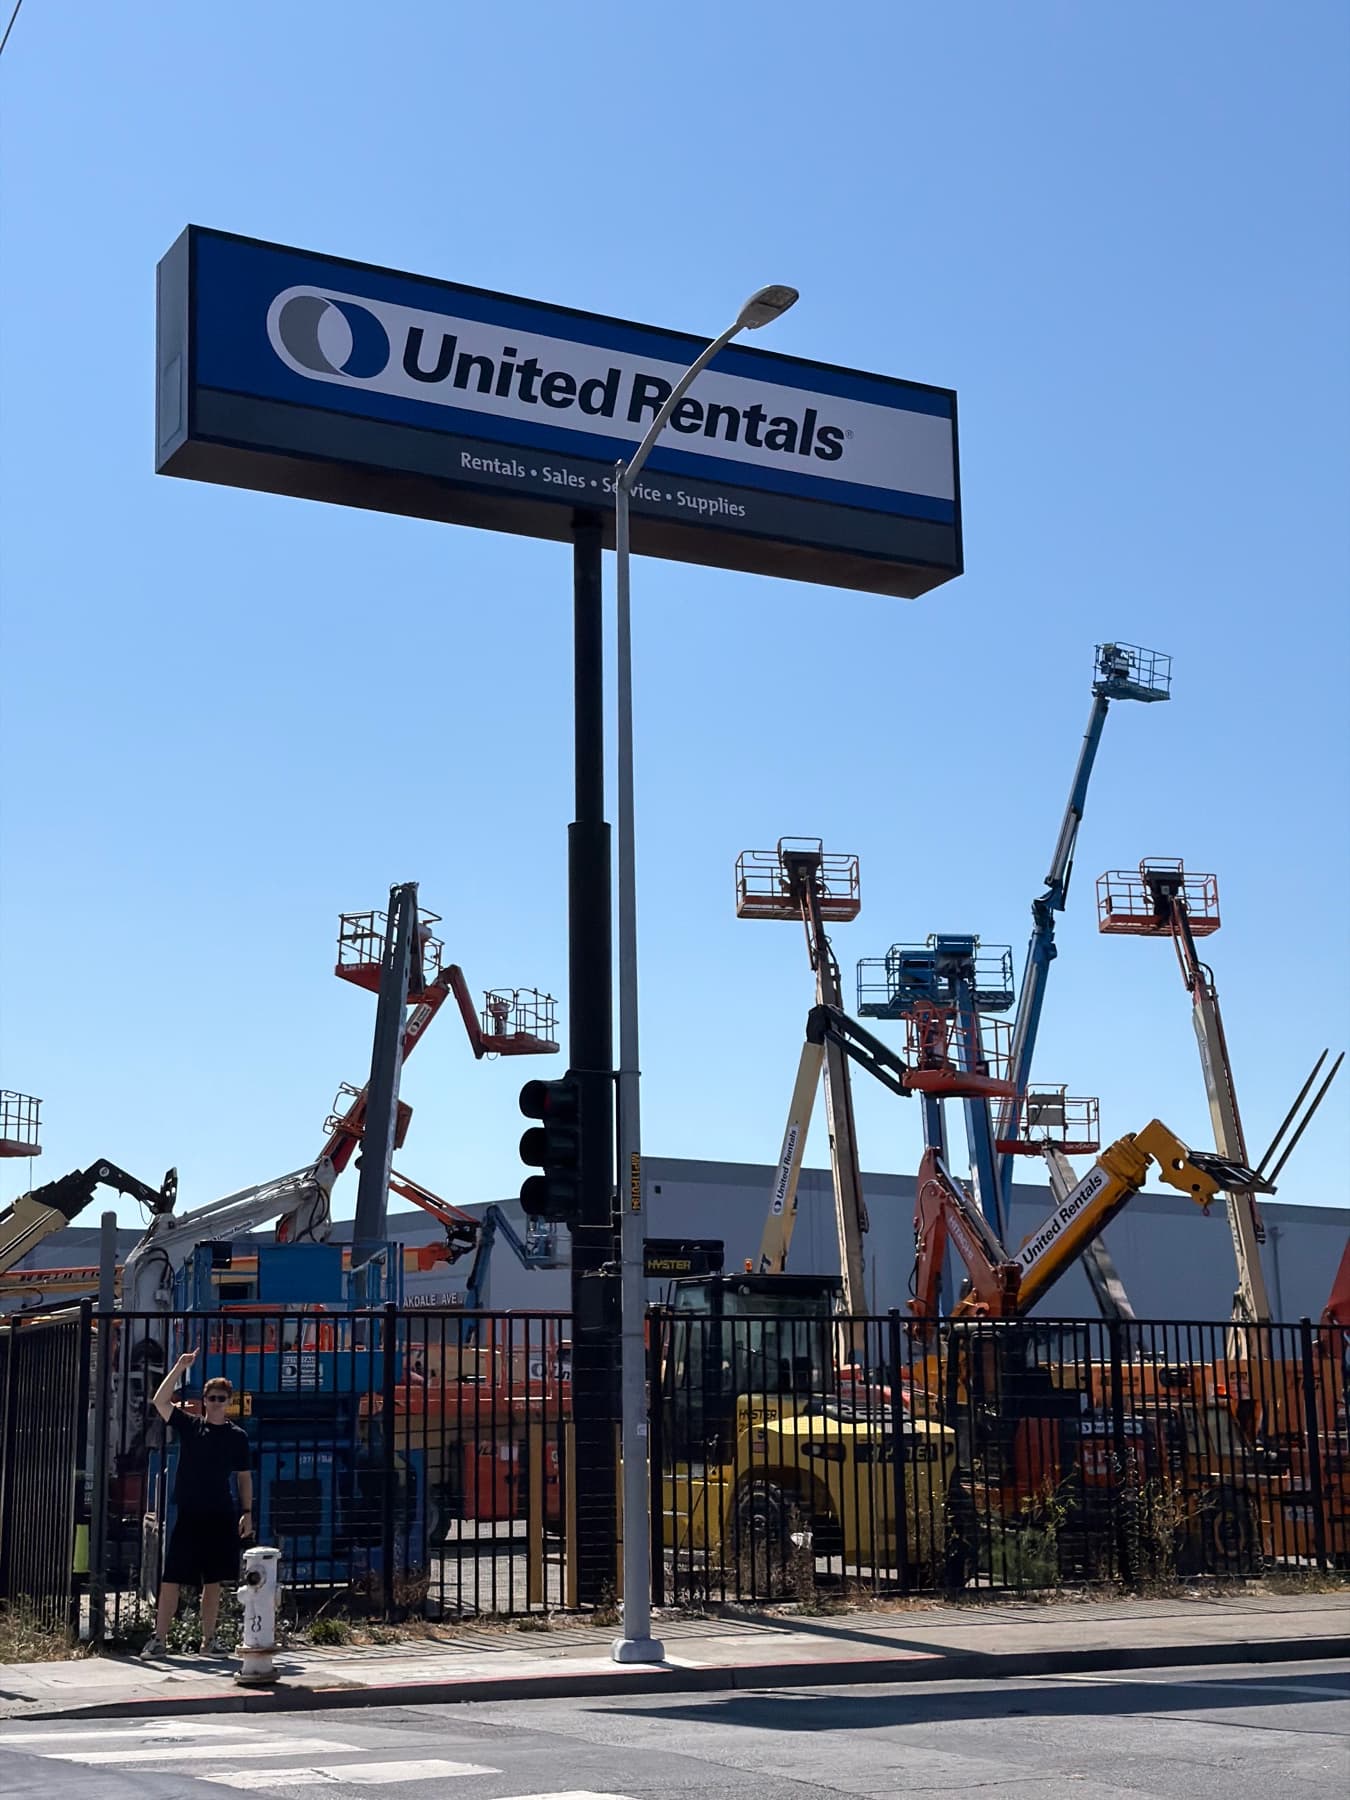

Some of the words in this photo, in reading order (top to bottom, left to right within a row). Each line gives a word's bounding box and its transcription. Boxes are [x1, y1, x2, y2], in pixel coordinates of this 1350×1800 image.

[403, 326, 622, 418] United
[627, 373, 844, 461] Rentals
[461, 452, 525, 478] Rentals
[542, 467, 586, 488] Sales
[602, 477, 661, 501] Sevice
[677, 491, 746, 517] Supplies
[777, 1166, 789, 1199] United
[783, 1129, 797, 1166] Rentals
[1022, 1218, 1061, 1264] United
[1059, 1175, 1103, 1223] Rentals
[647, 1259, 692, 1270] HYSTER
[403, 1294, 436, 1308] AKDALE
[441, 1292, 457, 1305] AVE
[739, 1409, 777, 1420] HSTER
